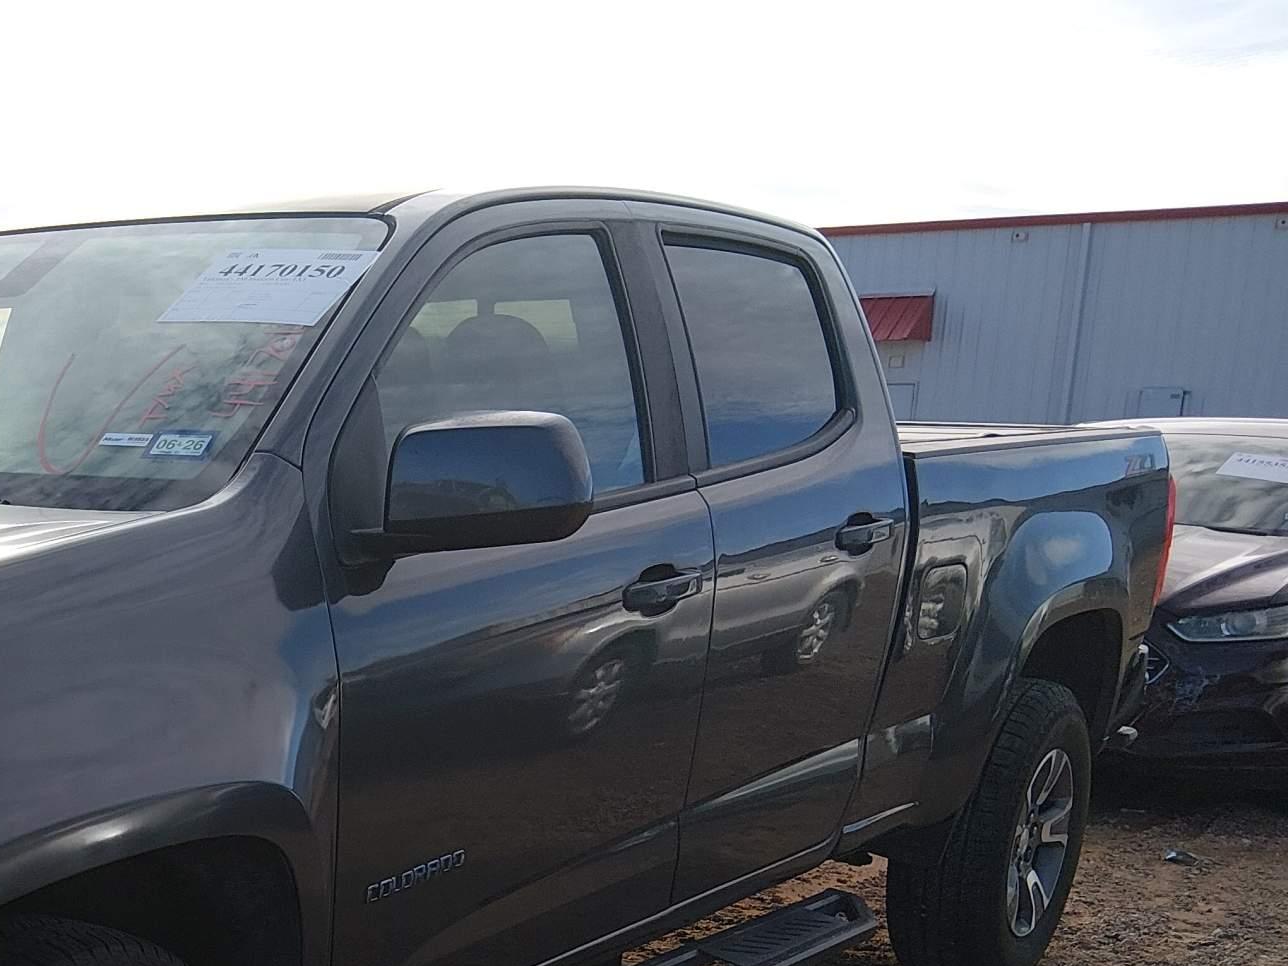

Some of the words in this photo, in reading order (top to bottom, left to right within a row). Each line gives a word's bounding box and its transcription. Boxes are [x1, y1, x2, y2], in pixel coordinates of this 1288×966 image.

[218, 262, 347, 279] 44170150
[155, 439, 178, 450] 06
[182, 439, 205, 451] 26
[366, 848, 466, 904] COLORADO
